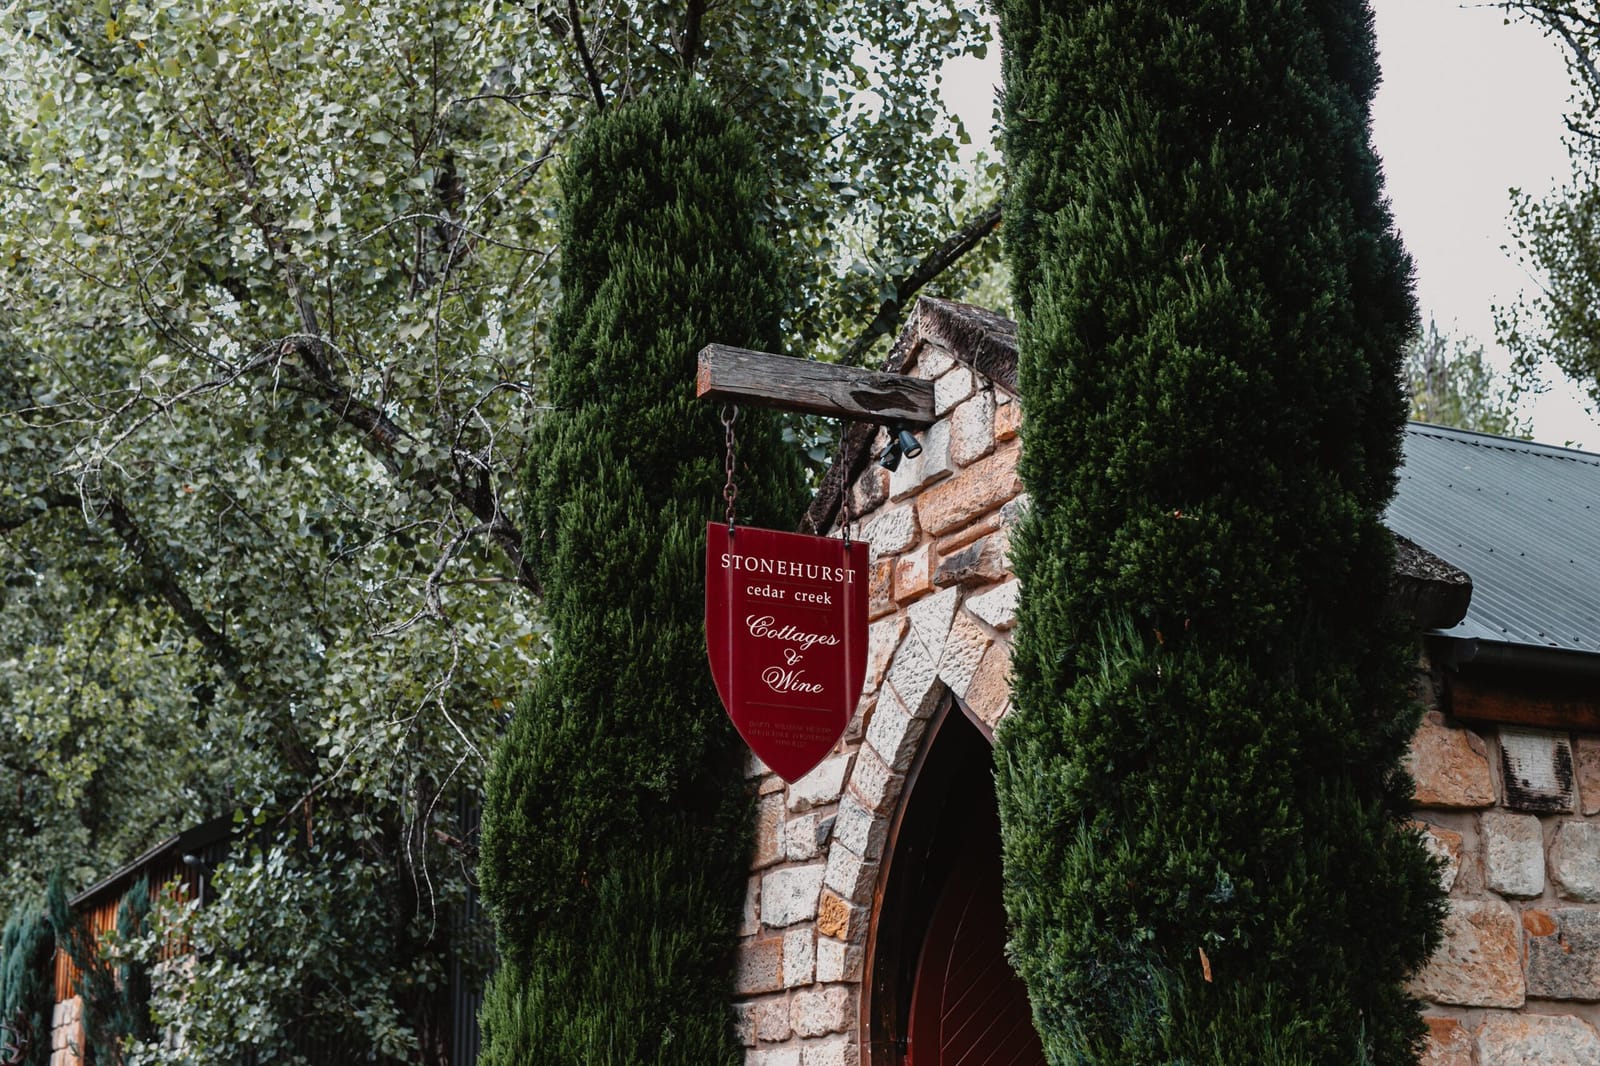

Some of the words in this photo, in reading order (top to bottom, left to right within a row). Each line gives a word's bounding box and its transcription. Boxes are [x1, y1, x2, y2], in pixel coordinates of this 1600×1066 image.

[721, 553, 856, 584] STONEHURST
[746, 585, 786, 599] cedar
[794, 591, 832, 605] creek
[746, 614, 840, 651] Cottages
[783, 648, 803, 666] &
[761, 666, 824, 694] Wine
